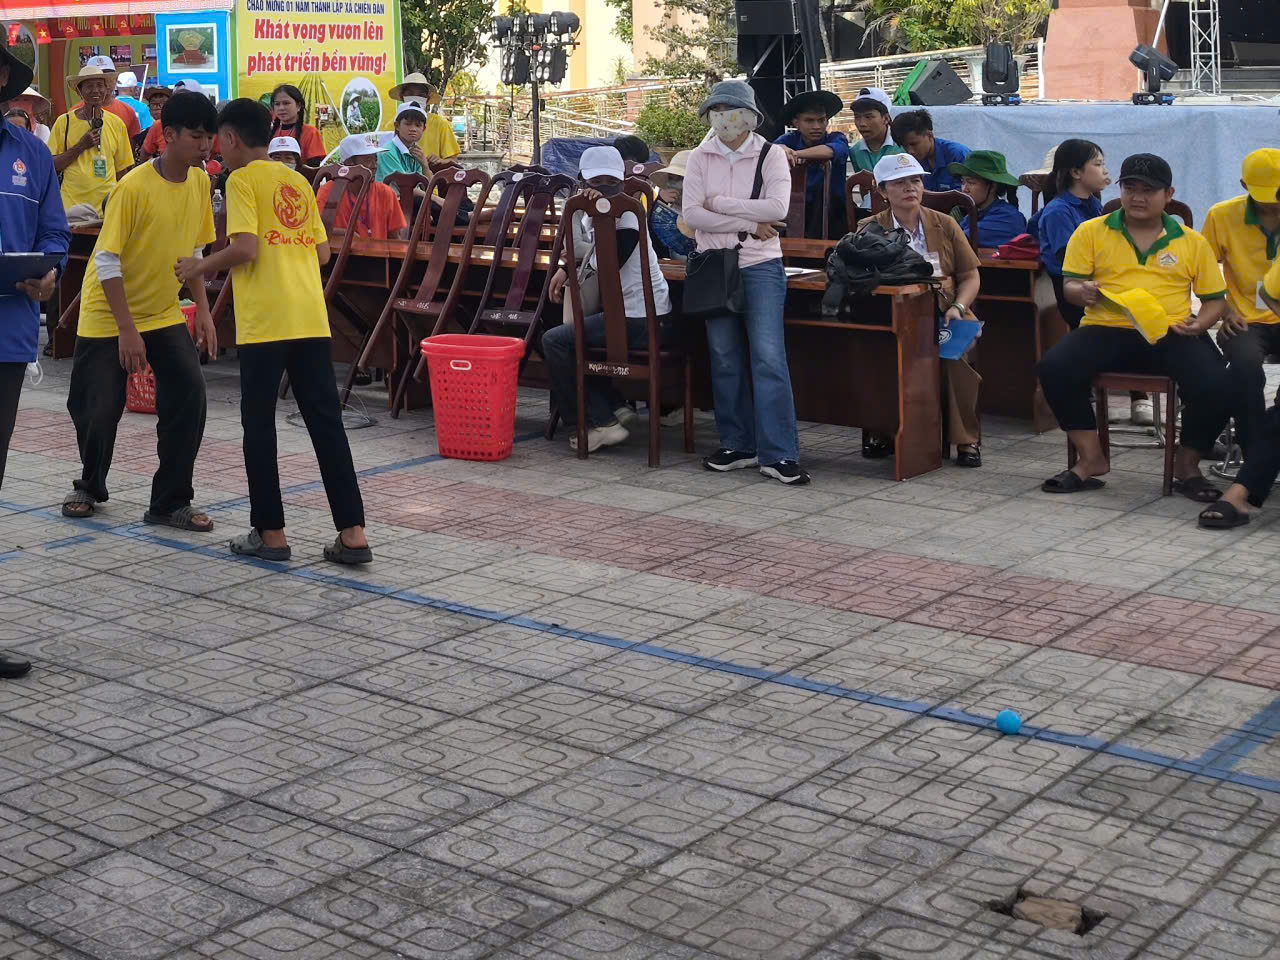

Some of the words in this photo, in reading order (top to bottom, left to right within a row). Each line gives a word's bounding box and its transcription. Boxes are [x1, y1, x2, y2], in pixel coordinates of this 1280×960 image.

[286, 1, 294, 12] 01
[254, 18, 290, 40] Khát
[293, 23, 326, 44] vọng
[363, 20, 384, 41] lên
[247, 50, 282, 78] phát
[284, 47, 320, 73] triển
[321, 49, 347, 73] bền
[349, 52, 387, 76] vững!
